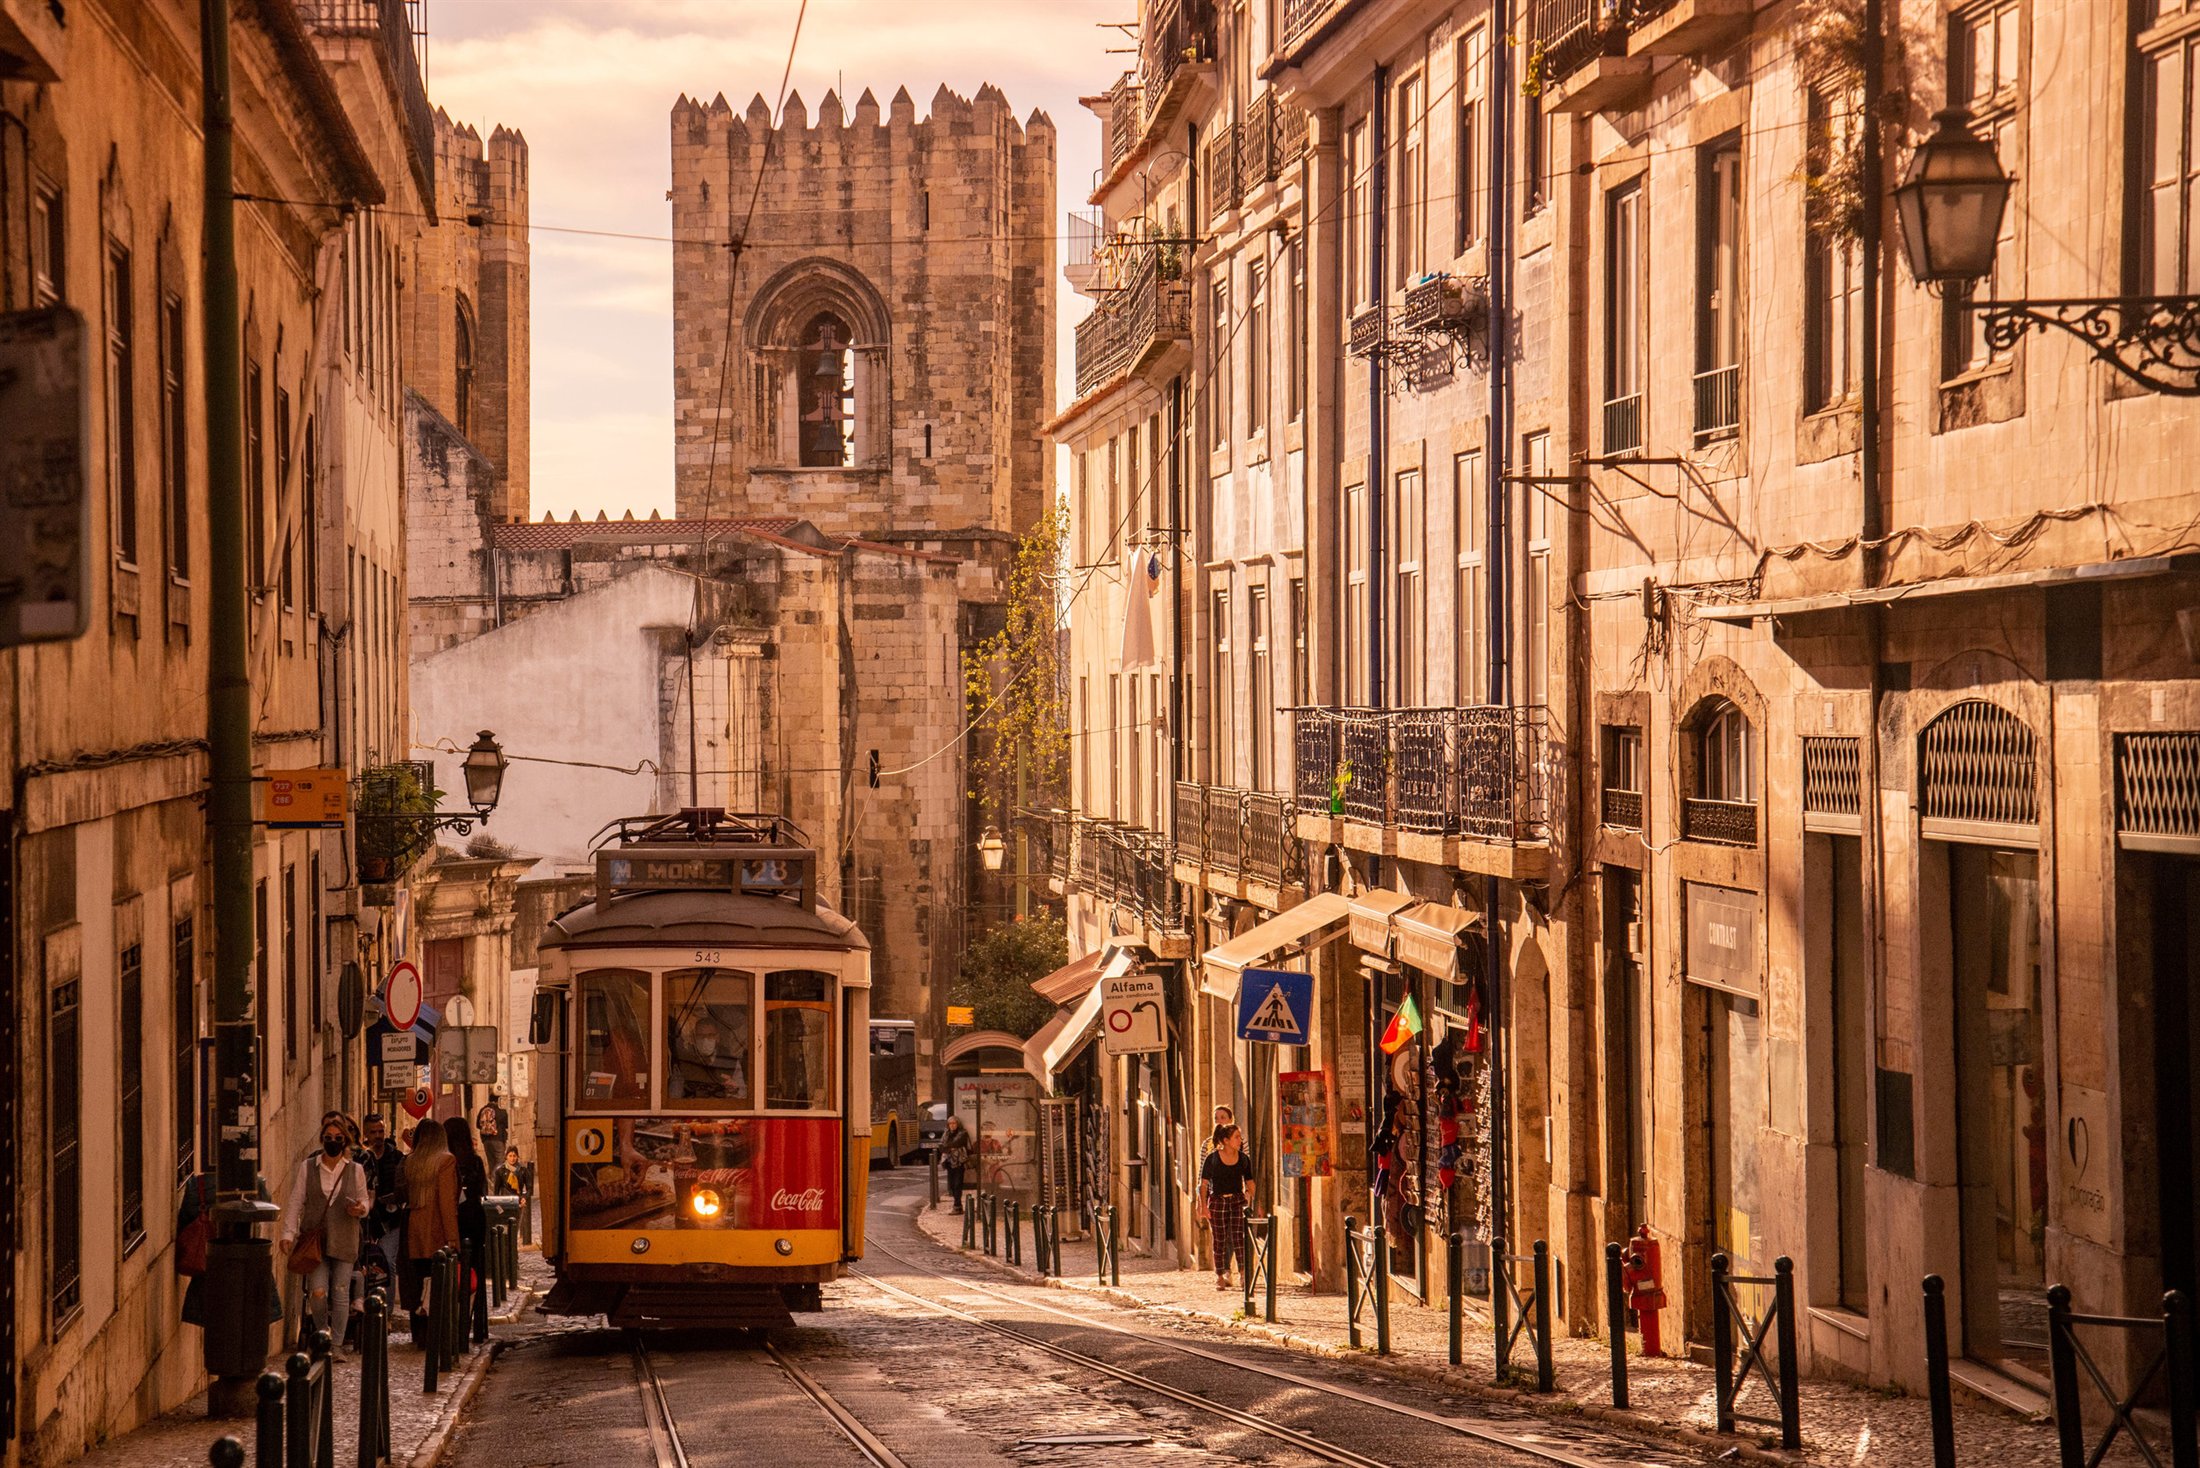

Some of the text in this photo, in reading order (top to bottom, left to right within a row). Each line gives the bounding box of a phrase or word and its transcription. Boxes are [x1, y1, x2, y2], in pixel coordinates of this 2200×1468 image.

[648, 861, 722, 880] MONIZ
[751, 860, 788, 882] 28
[1708, 921, 1737, 950] CONTRAST
[695, 951, 721, 964] 543
[1110, 981, 1154, 993] Alfama
[1126, 991, 1160, 999] condicionado
[585, 1087, 596, 1097] 01
[770, 1188, 826, 1212] Coca-Cola
